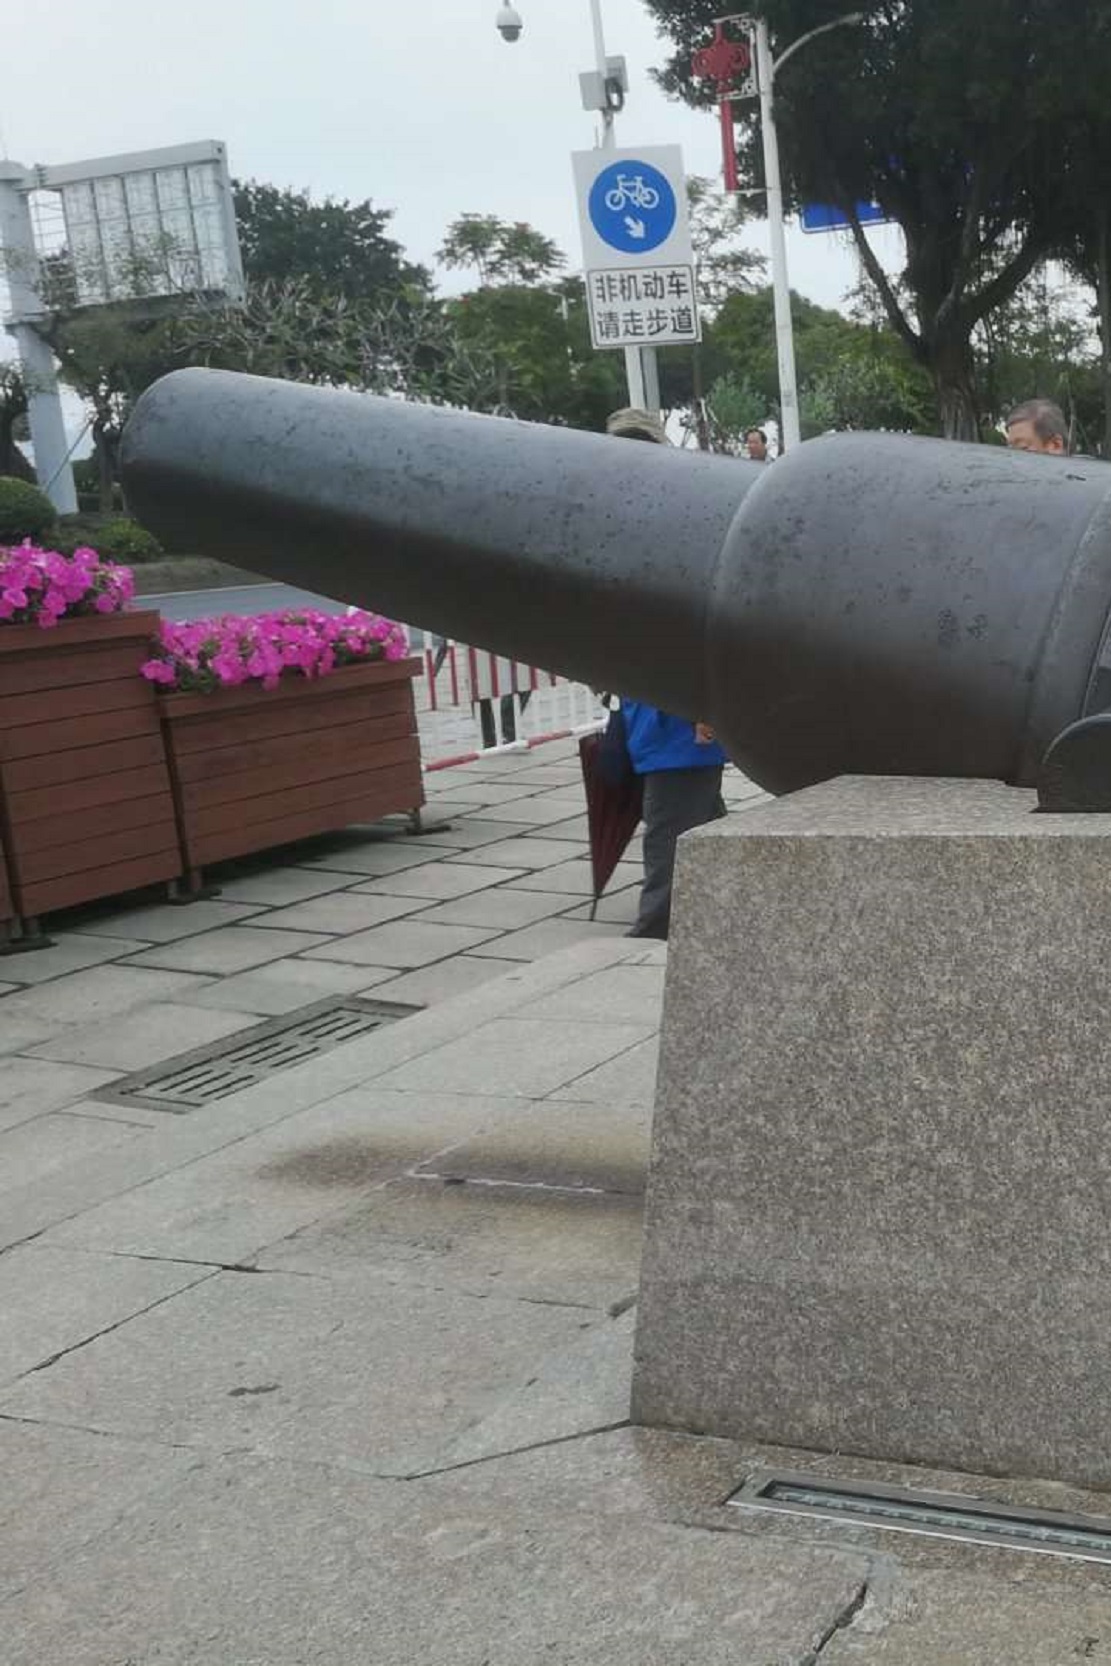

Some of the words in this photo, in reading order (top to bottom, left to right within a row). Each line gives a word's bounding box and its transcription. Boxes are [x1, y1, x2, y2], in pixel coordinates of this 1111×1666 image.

[595, 271, 689, 303] 非机动车
[597, 305, 694, 339] 请走步道
